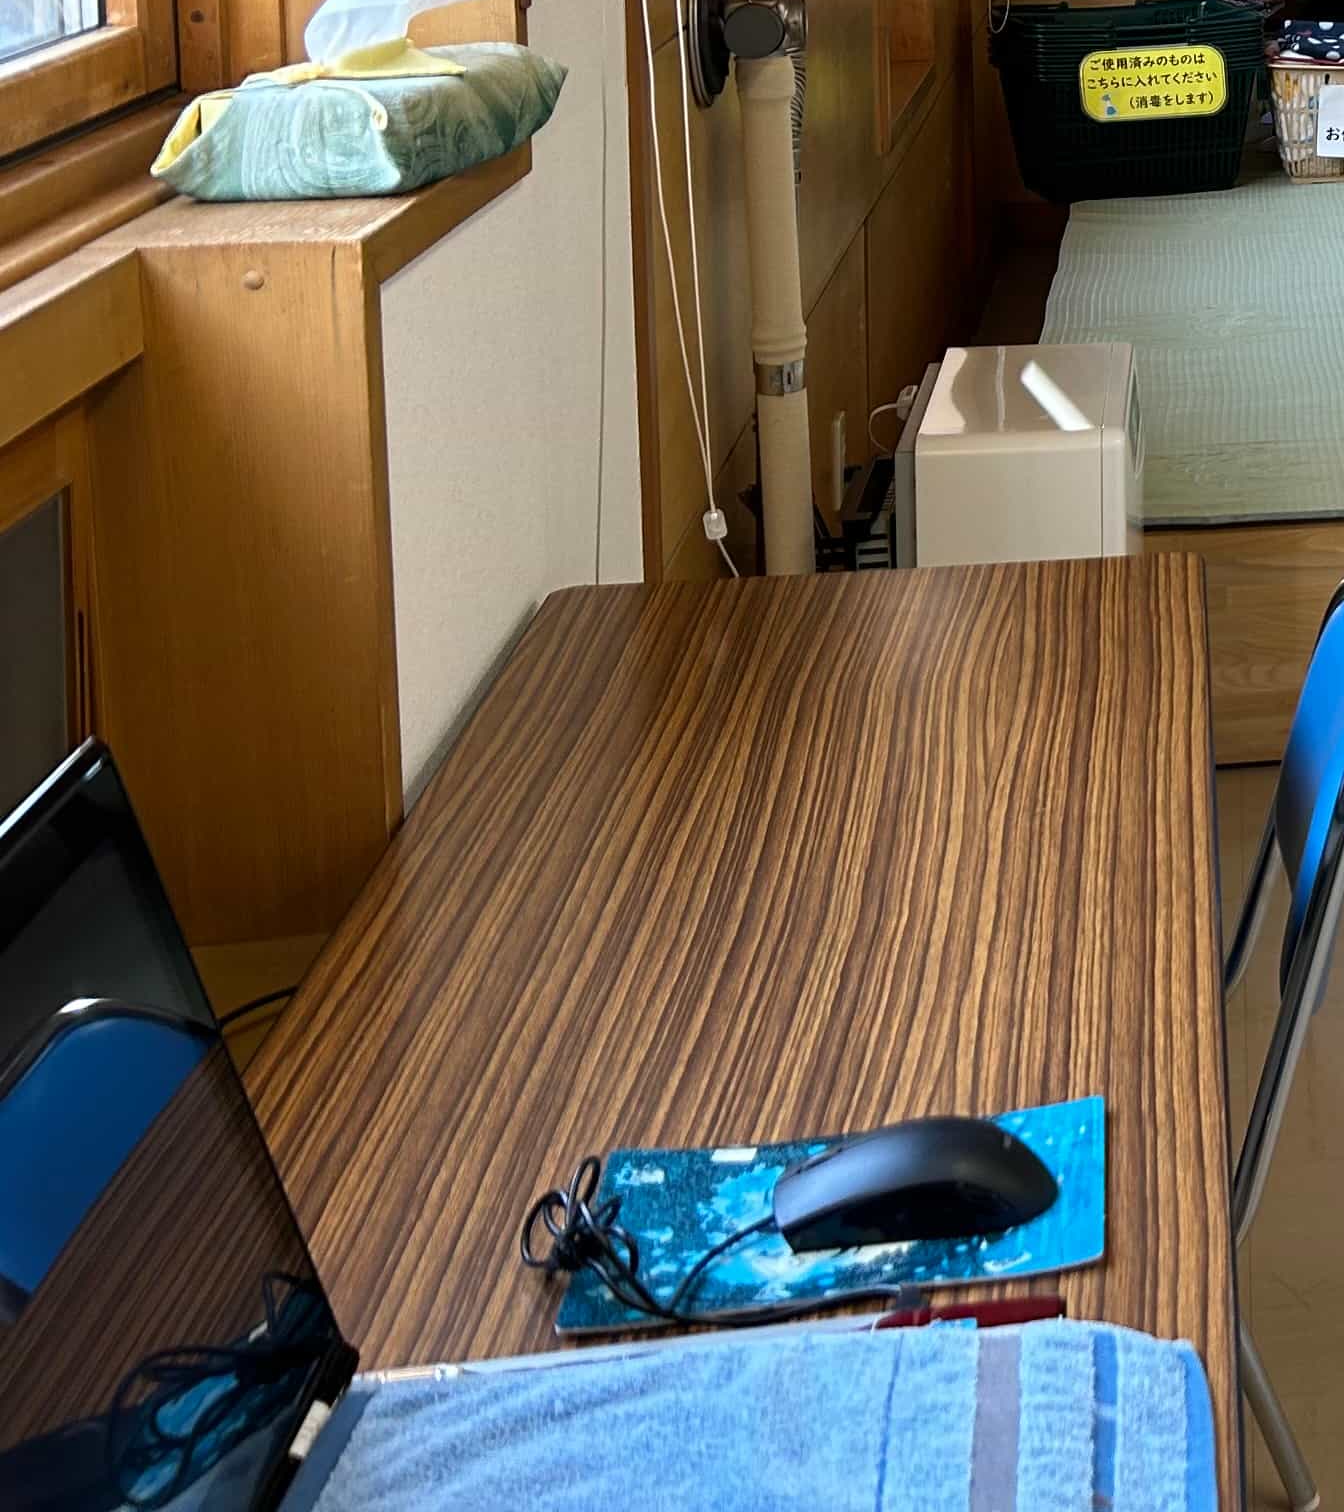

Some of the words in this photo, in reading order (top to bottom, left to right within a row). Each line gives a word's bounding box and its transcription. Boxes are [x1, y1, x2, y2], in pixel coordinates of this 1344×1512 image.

[1090, 53, 1206, 71] ご使用済みのものは
[1087, 71, 1218, 90] こちらに入れてください
[1129, 90, 1214, 109] (消毒をします)
